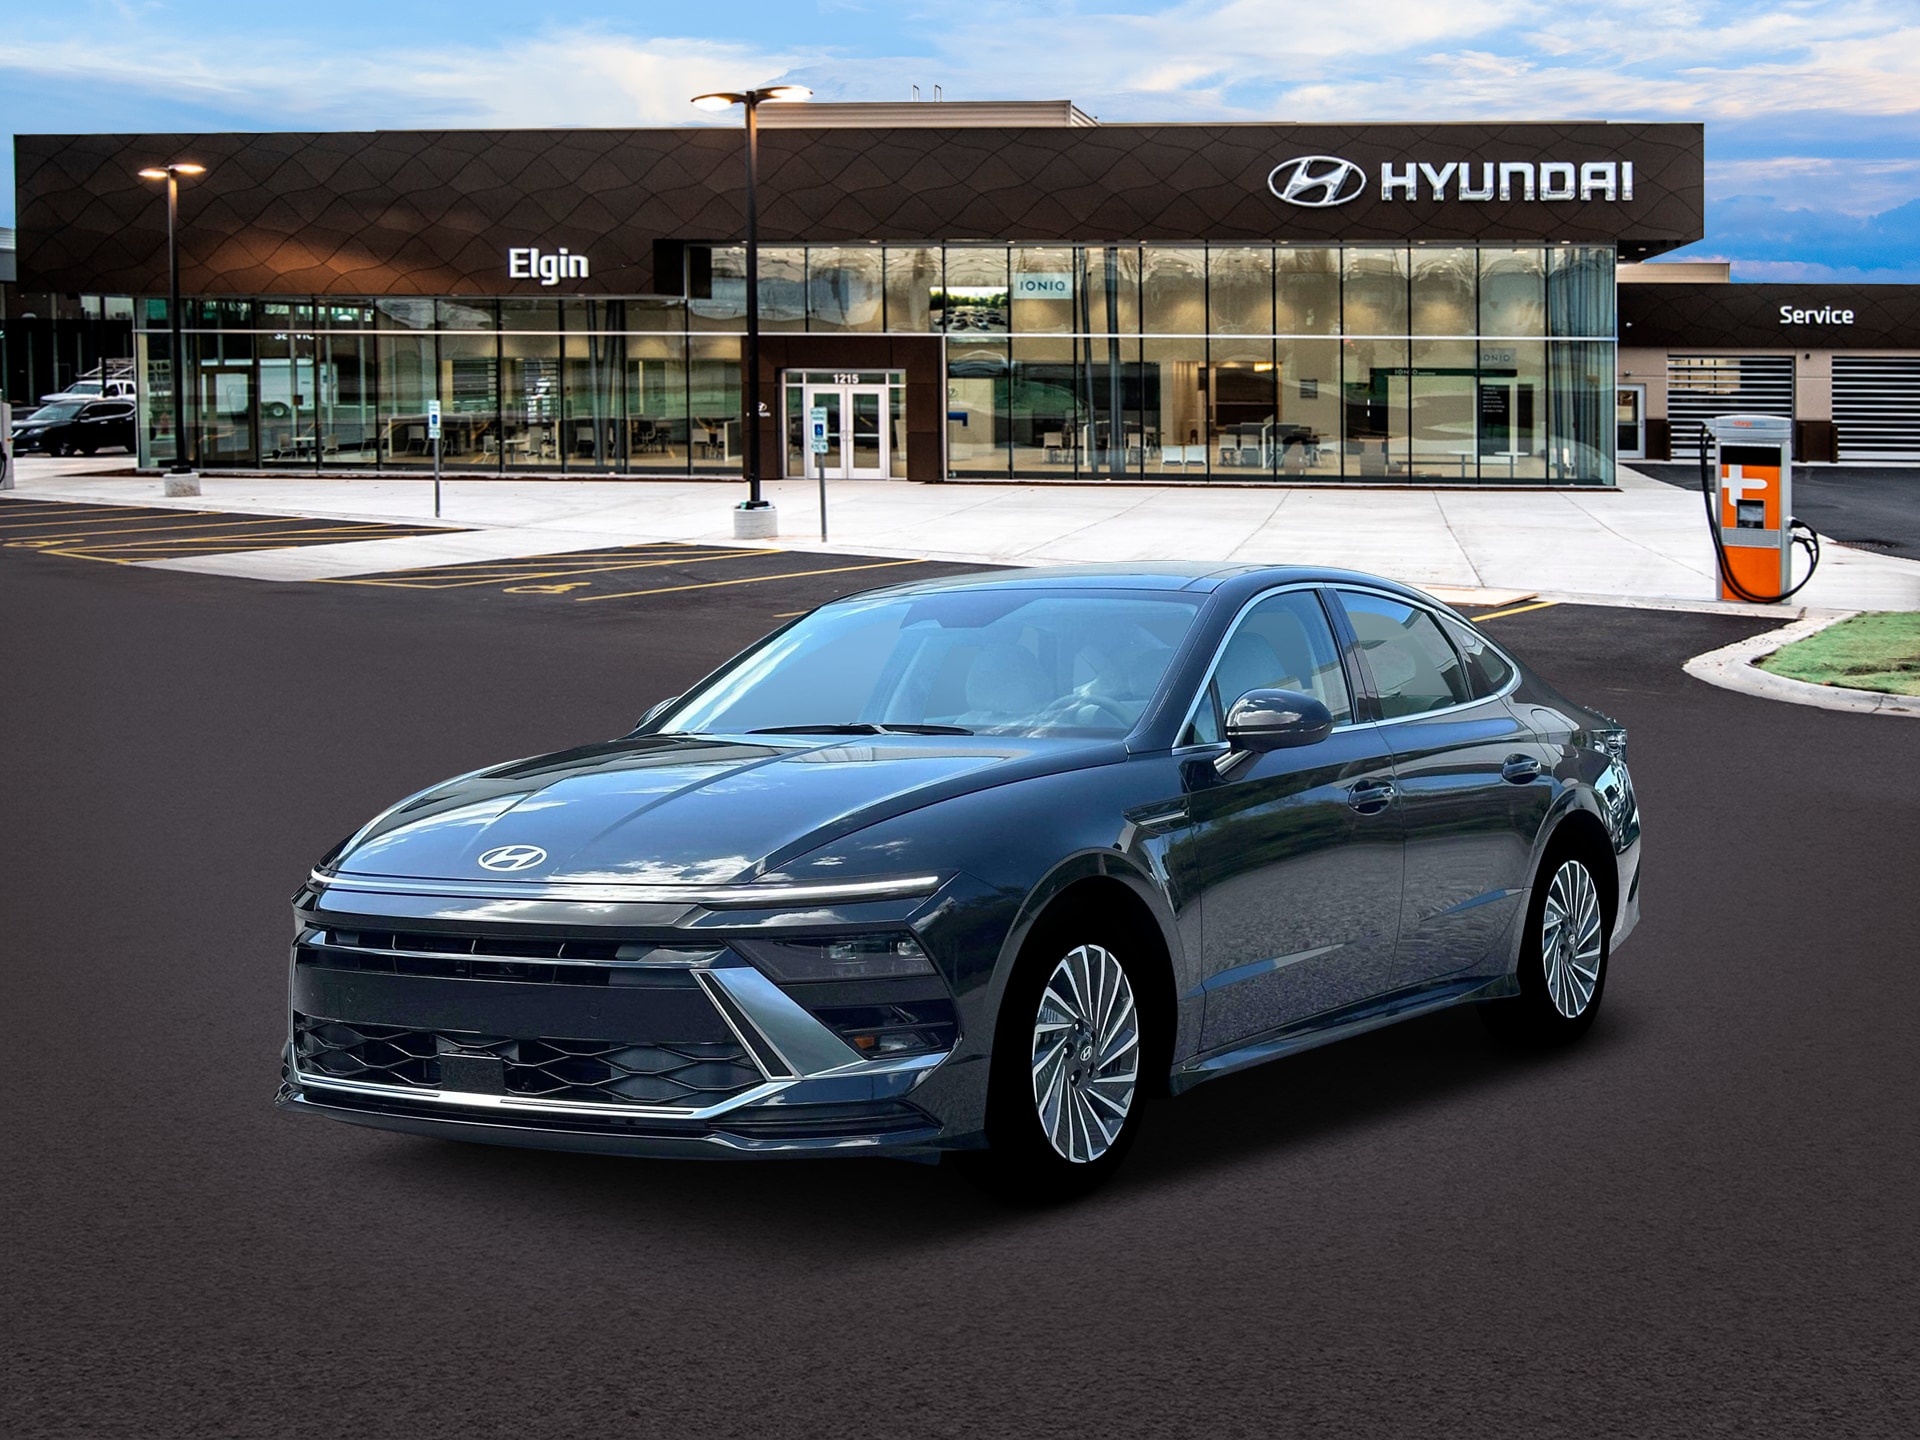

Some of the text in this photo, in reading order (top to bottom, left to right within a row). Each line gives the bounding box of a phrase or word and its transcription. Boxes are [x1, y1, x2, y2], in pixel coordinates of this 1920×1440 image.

[1380, 161, 1634, 202] HYUNDAI
[508, 247, 589, 286] Elgin
[1020, 281, 1065, 291] IONIQ
[1779, 305, 1854, 324] Service
[833, 373, 859, 384] 1215
